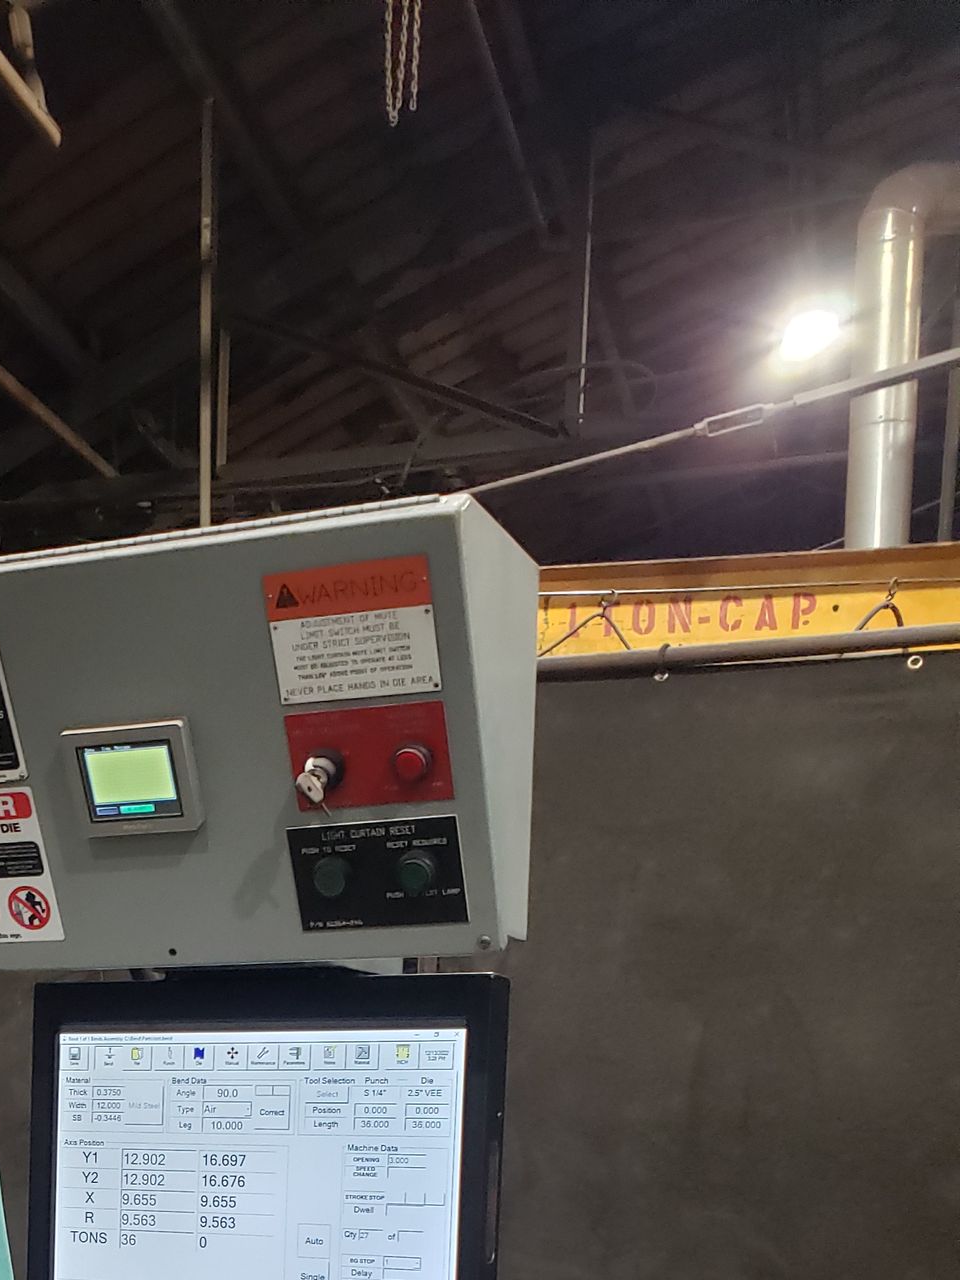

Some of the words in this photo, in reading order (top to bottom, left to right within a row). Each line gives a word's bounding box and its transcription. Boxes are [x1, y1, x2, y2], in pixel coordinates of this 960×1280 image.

[297, 571, 418, 605] WARNING
[328, 627, 360, 638] SWITCH
[363, 624, 385, 633] MUST
[292, 641, 318, 652] UNDER
[322, 638, 350, 649] STRICT
[285, 686, 314, 697] NEVER
[317, 684, 343, 694] PLACE
[347, 681, 376, 691] HANDS
[379, 680, 390, 688] IN
[392, 678, 406, 687] DIE
[410, 675, 434, 685] AREA
[1, 822, 21, 834] DIE
[321, 831, 345, 842] LIGHT
[350, 827, 385, 839] CURTAIN
[390, 825, 416, 836] RESET
[66, 1076, 91, 1084] Material
[172, 1077, 190, 1085] Bend
[191, 1077, 207, 1085] Data
[304, 1077, 320, 1085] Tool
[321, 1077, 356, 1085] Selection
[365, 1077, 389, 1085] Punch
[421, 1077, 434, 1085] Die
[68, 1088, 88, 1097] Thick
[96, 1088, 121, 1096] 0.3750
[176, 1089, 196, 1098] Angle
[217, 1088, 238, 1098] 90.0
[316, 1090, 339, 1098] Select
[407, 1089, 423, 1097] 2.5"
[424, 1089, 442, 1097] VEE
[69, 1101, 87, 1109] Width
[96, 1101, 121, 1110] 12.000
[176, 1105, 194, 1114] Type
[204, 1105, 217, 1113] Air
[312, 1106, 341, 1115] Position
[364, 1106, 387, 1114] 0.000
[415, 1106, 439, 1115] 0.000
[259, 1108, 285, 1116] Correct
[72, 1114, 82, 1122] SB
[94, 1114, 122, 1122] -0.3446
[179, 1121, 192, 1130] Leg
[211, 1120, 243, 1131] 10.000
[313, 1120, 339, 1130] Length
[360, 1121, 389, 1129] 36.000
[412, 1121, 441, 1129] 36.000
[79, 1139, 104, 1147] Position
[347, 1144, 379, 1152] Machine
[380, 1145, 399, 1153] Data
[82, 1151, 98, 1164] Y1
[124, 1153, 166, 1166] 12.902
[203, 1154, 246, 1167] 16.697
[82, 1171, 99, 1184] Y2
[123, 1173, 165, 1187] 12.902
[202, 1175, 246, 1188] 16.676
[85, 1191, 95, 1204] X
[122, 1193, 157, 1207] 9.655
[200, 1195, 237, 1209] 9.655
[353, 1206, 374, 1214] Dwell
[85, 1211, 95, 1224] R
[121, 1213, 156, 1227] 9.563
[200, 1216, 236, 1229] 9.563
[70, 1230, 108, 1244] TONS
[121, 1233, 137, 1246] 36
[199, 1236, 207, 1249] 0
[305, 1237, 324, 1246] Auto
[351, 1269, 373, 1279] Delay
